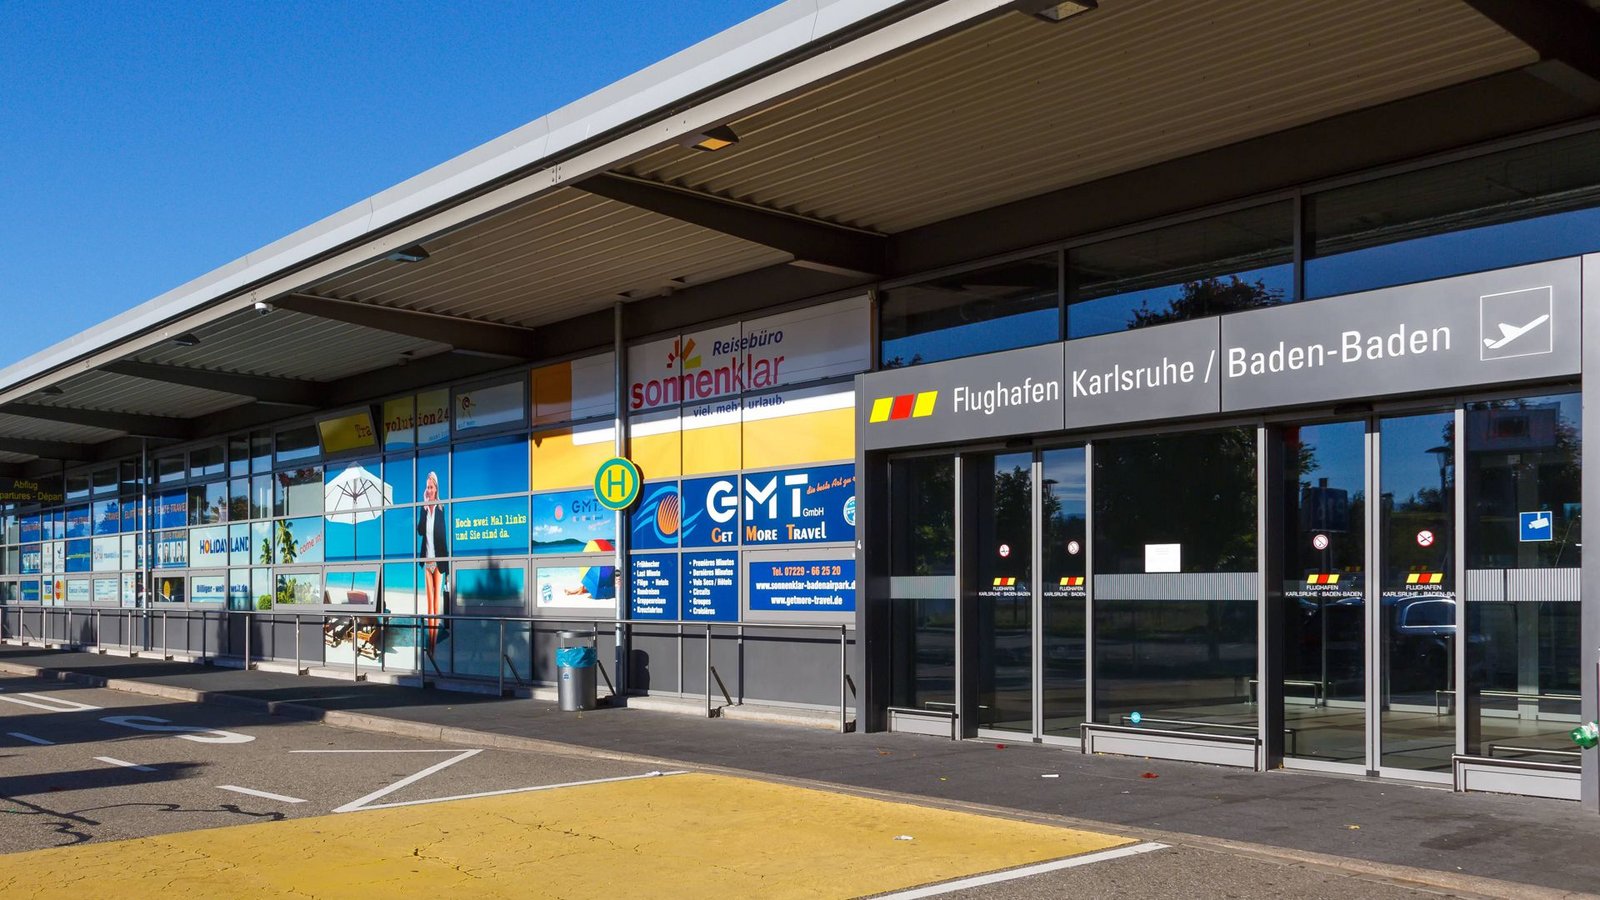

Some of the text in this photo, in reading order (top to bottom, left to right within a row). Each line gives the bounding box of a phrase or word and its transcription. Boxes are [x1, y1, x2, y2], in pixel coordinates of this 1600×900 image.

[712, 329, 783, 356] Reisebüro
[953, 323, 1451, 415] Flughafen Karlsruhe / Baden-Baden
[631, 353, 785, 409] sonnenklar
[693, 403, 713, 417] viel.
[748, 394, 786, 410] urlaub.
[14, 480, 38, 491] Abflug
[608, 469, 626, 497] H
[706, 473, 809, 523] GMT
[802, 507, 825, 518] GmbH
[455, 514, 527, 528] Noch zwei Mal links
[455, 528, 510, 541] und Sie sind da.
[746, 525, 778, 541] MORE
[199, 538, 228, 554] HOLIDAY
[772, 567, 782, 576] Tel.
[784, 566, 805, 576] 07229
[811, 566, 820, 576] 66
[821, 566, 831, 576] 25
[832, 566, 841, 576] 20
